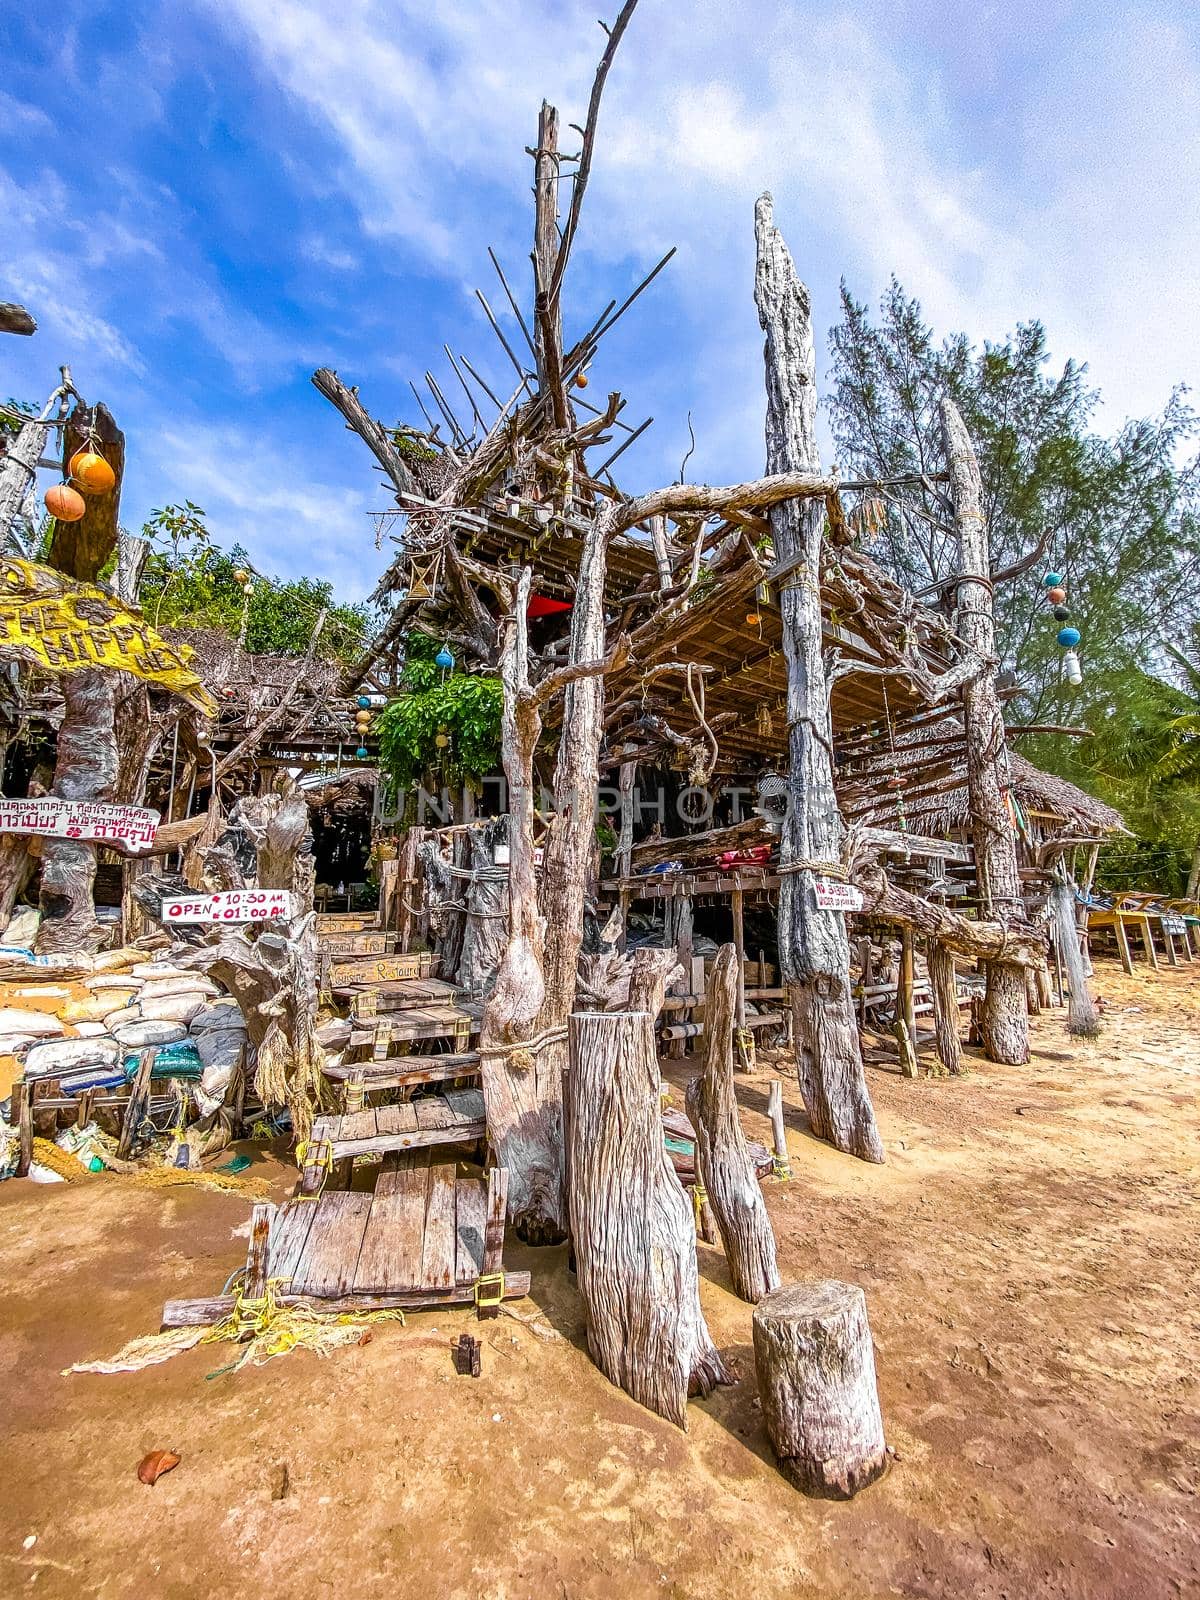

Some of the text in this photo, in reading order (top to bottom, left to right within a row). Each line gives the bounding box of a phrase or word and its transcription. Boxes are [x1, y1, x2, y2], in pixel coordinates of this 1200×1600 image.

[41, 622, 152, 664] HIPPY
[226, 894, 266, 905] 10:30
[168, 903, 213, 917] OPEN
[223, 907, 268, 919] 01:00
